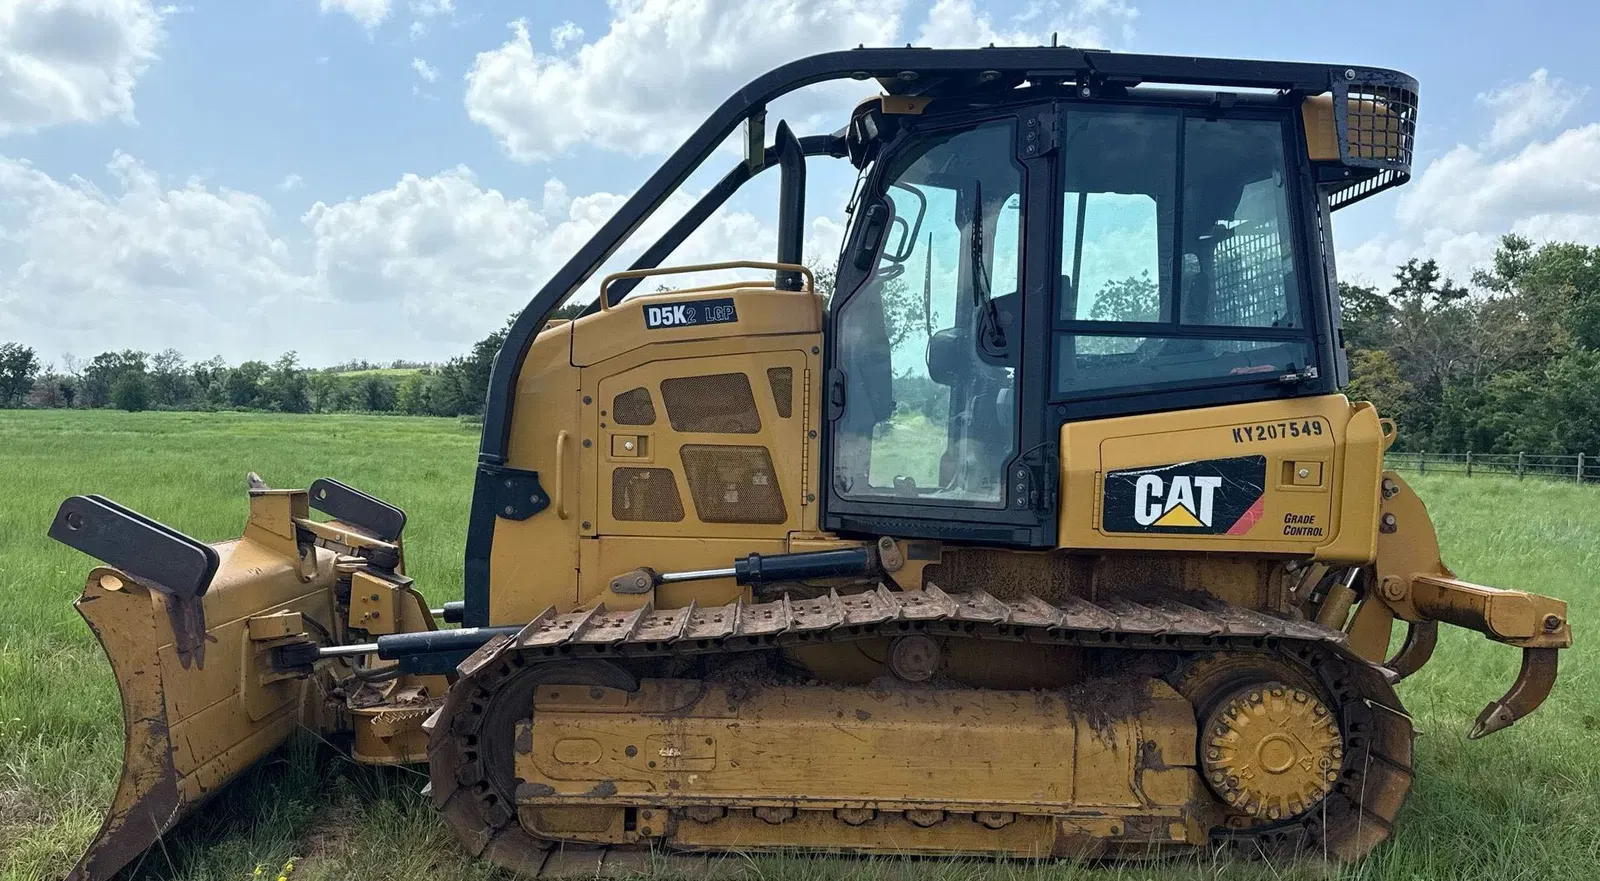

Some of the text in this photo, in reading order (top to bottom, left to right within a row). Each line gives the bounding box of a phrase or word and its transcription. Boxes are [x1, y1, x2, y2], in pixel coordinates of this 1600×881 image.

[705, 306, 734, 322] LGP
[1232, 420, 1323, 443] KY207549
[1134, 474, 1222, 527] CAT
[1283, 512, 1315, 525] GRADE
[1283, 524, 1323, 537] CONTROL
